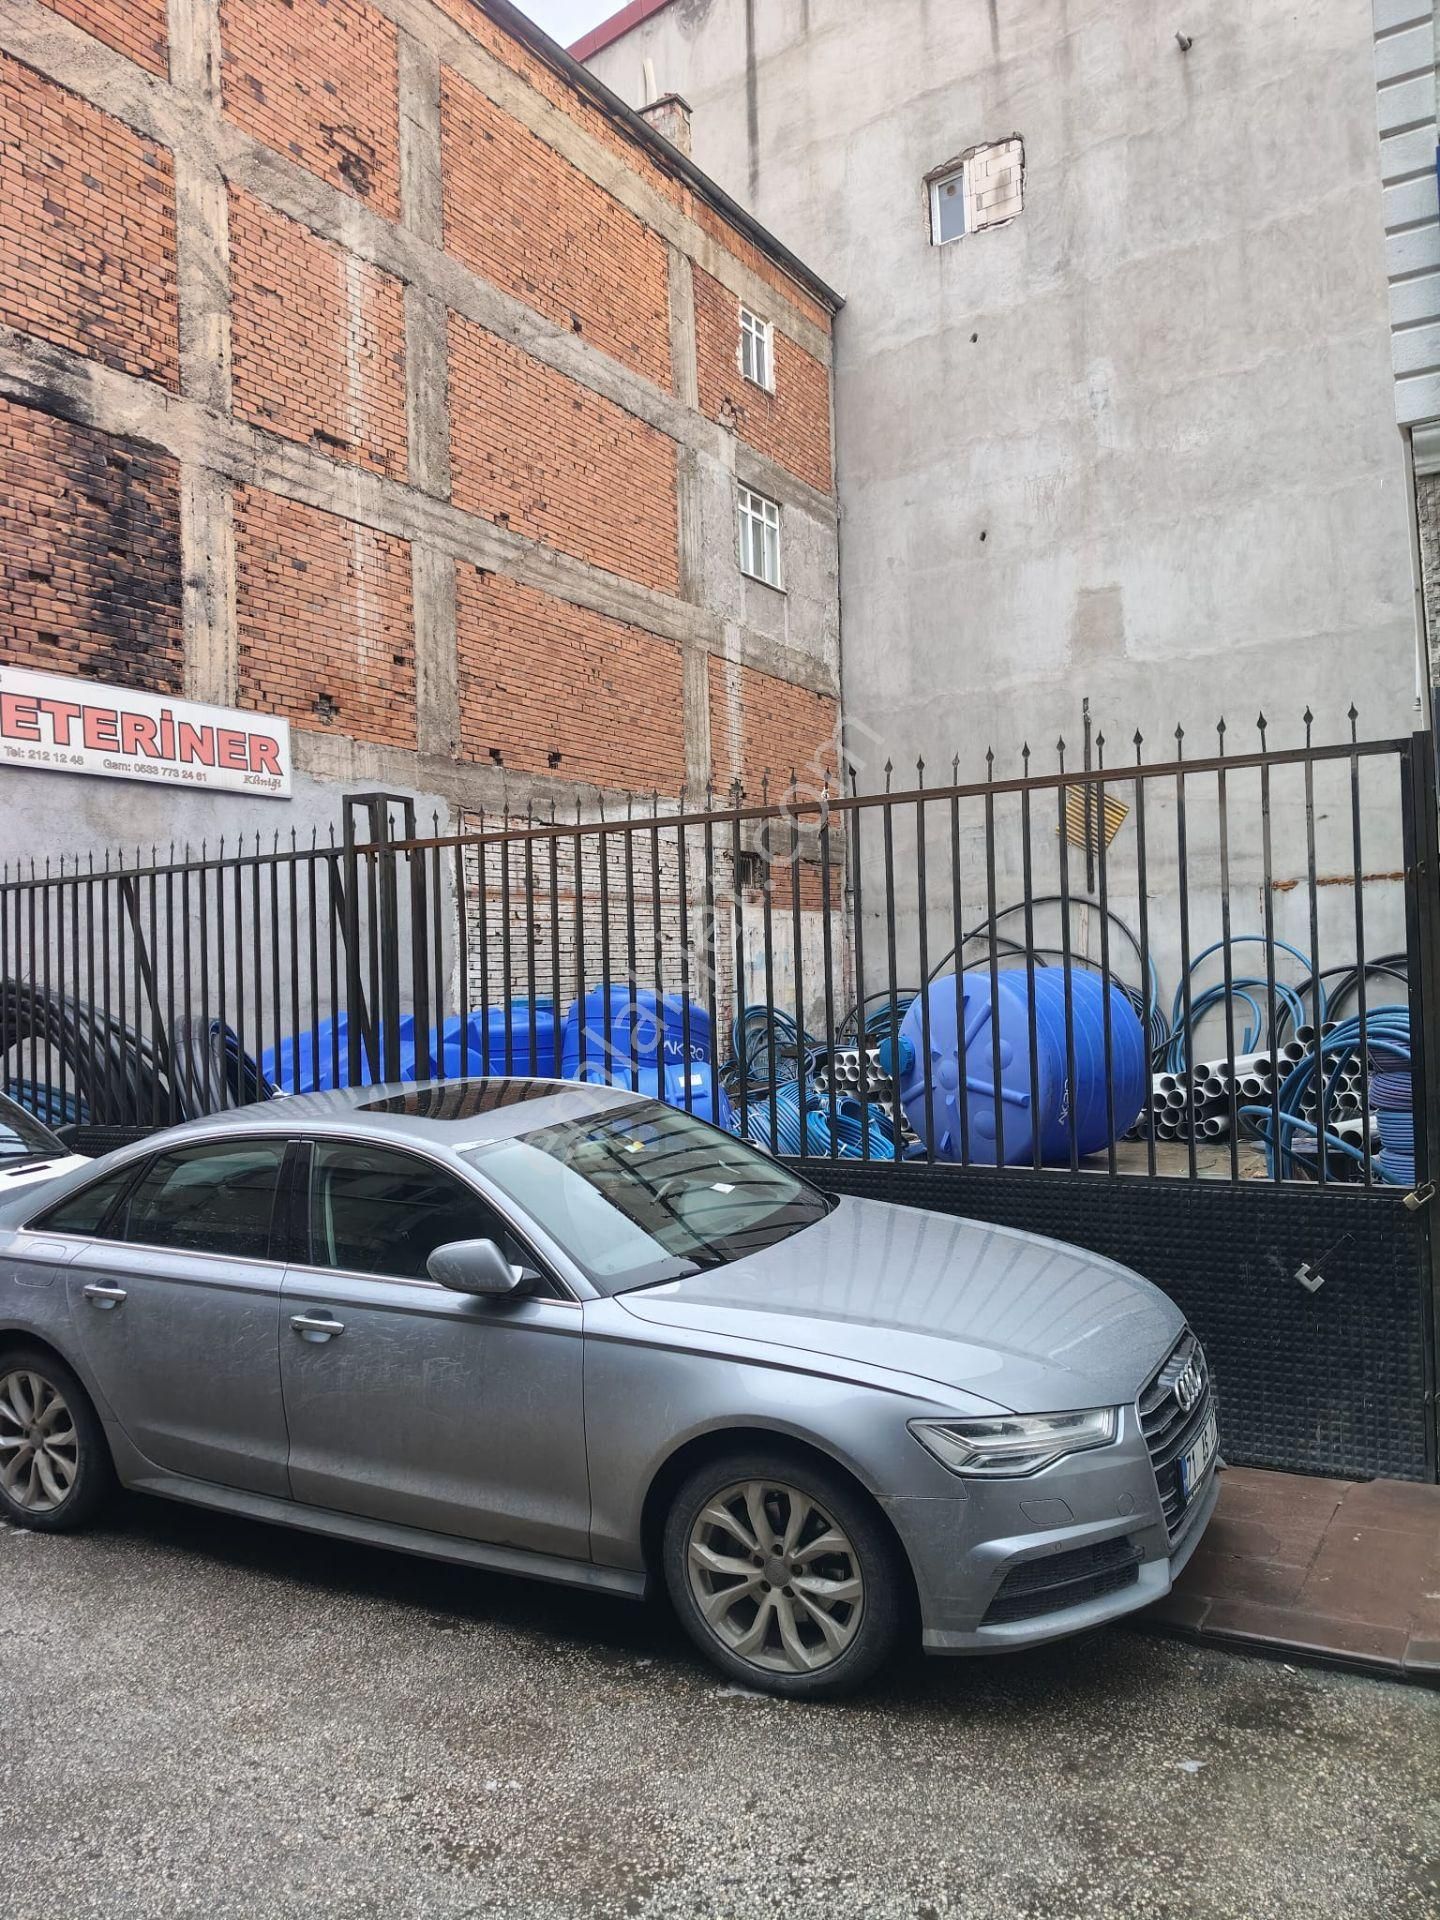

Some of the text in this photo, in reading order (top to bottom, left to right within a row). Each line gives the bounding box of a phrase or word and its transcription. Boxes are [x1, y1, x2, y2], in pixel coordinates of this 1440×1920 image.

[4, 745, 25, 759] Tel:
[27, 749, 50, 761] 212
[53, 752, 67, 763] 12
[103, 758, 131, 772] Gsm:
[161, 766, 180, 778] 773
[182, 769, 194, 780] 24
